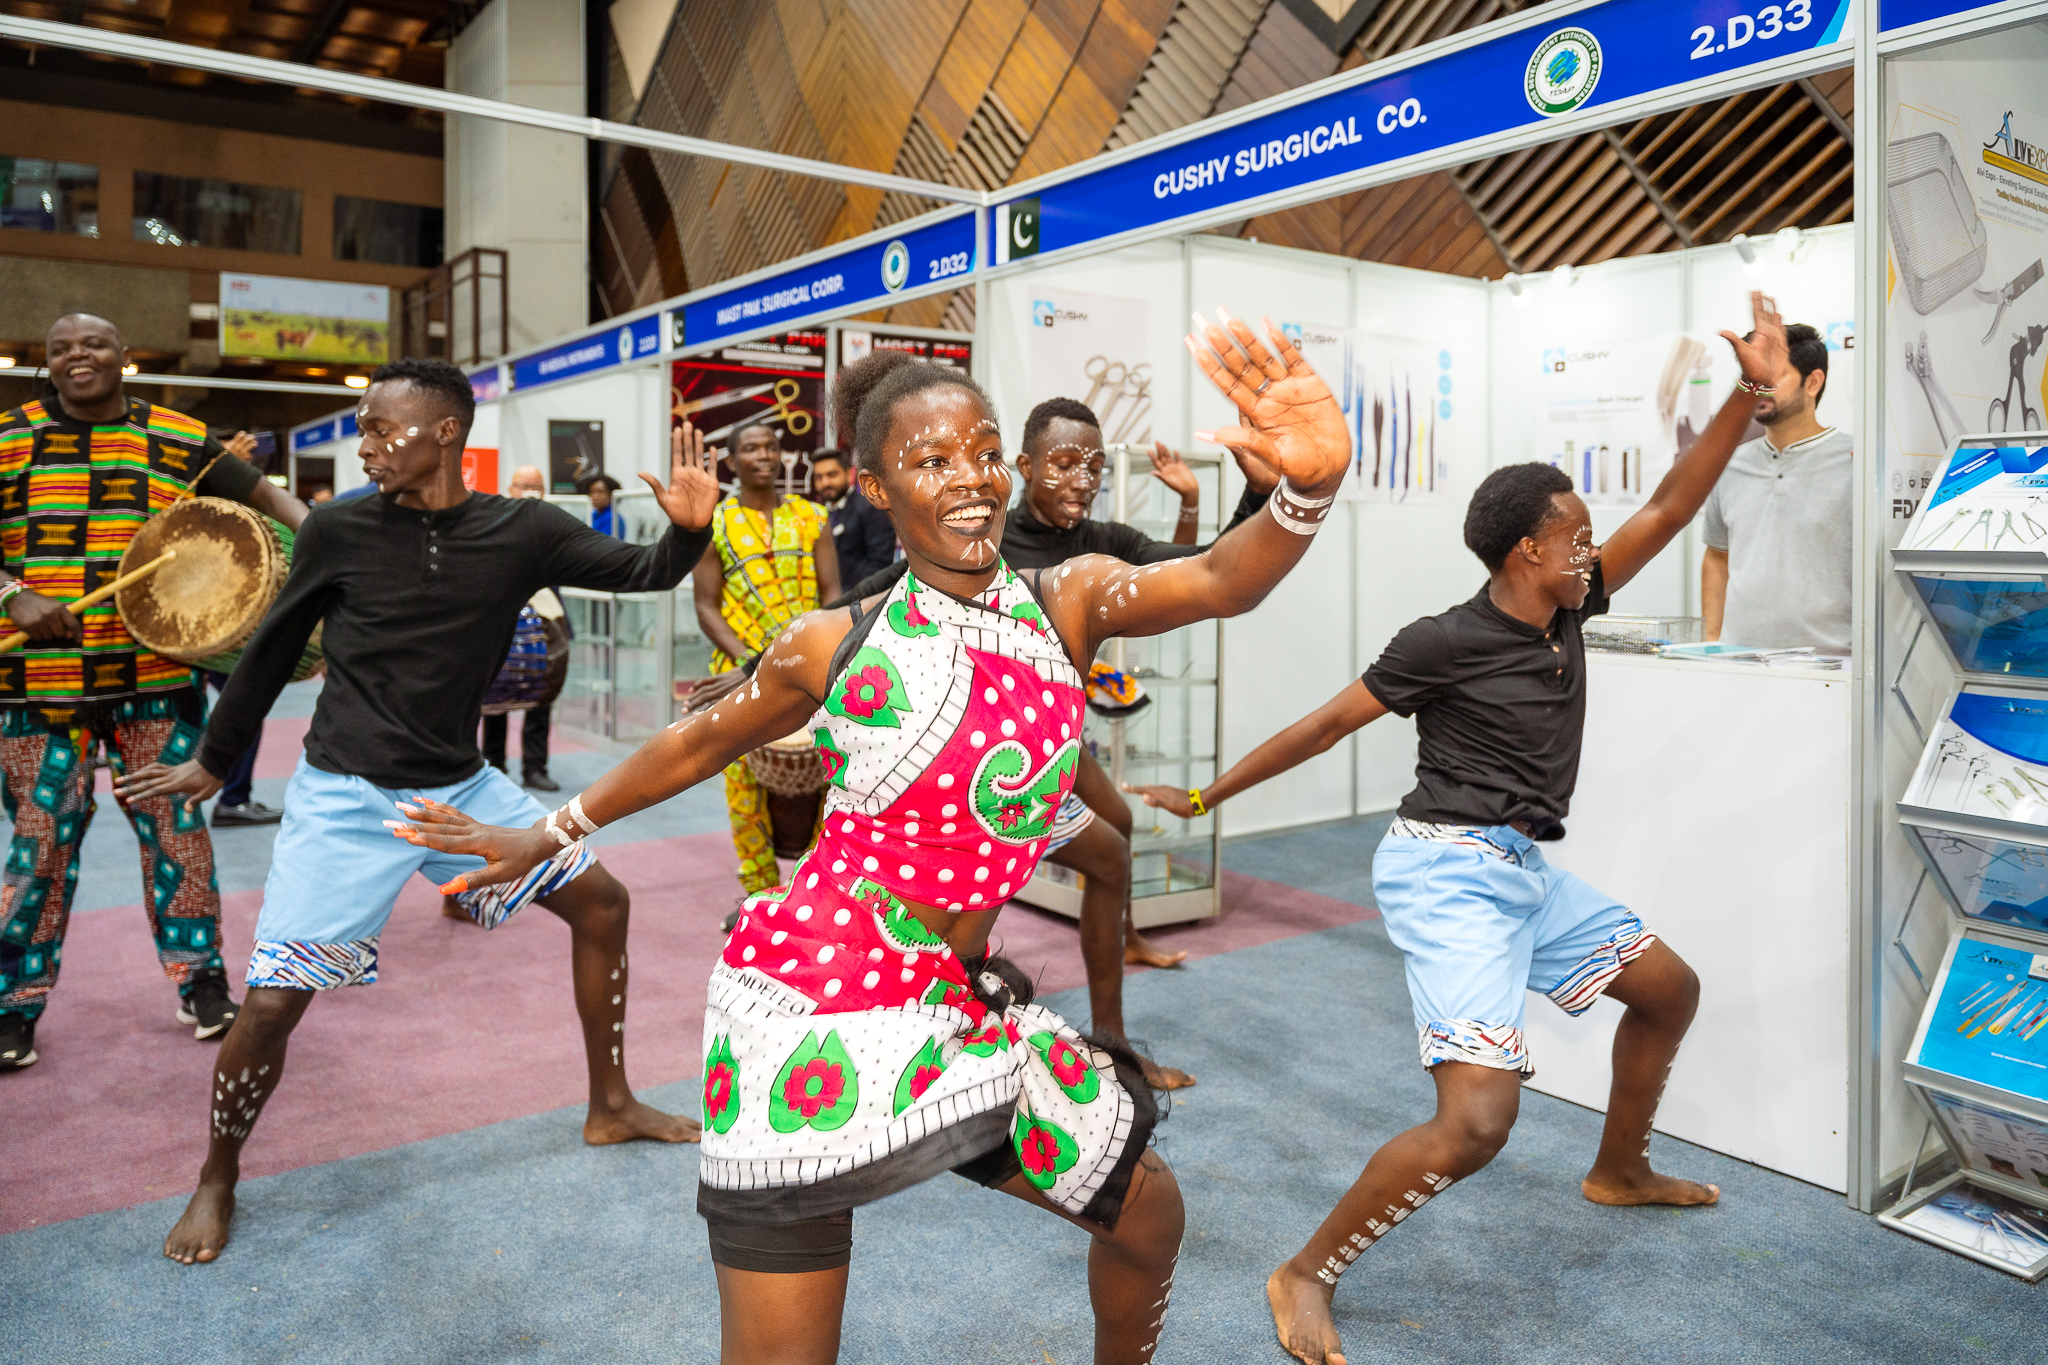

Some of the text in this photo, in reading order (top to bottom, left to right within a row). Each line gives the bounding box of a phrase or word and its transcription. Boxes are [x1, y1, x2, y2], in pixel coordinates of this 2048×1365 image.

[1690, 0, 1813, 60] 2.D33
[1560, 32, 1595, 50] AUTHORITY
[1153, 97, 1428, 199] CUSHY SURGICAL CO.
[1986, 170, 1997, 181] Expo
[1999, 175, 2018, 190] Elevating
[2018, 182, 2034, 195] Surgical
[929, 251, 969, 280] 2.D32
[761, 283, 811, 314] SURGICAL
[811, 273, 846, 299] CORP.
[1054, 309, 1089, 321] CUSHY
[1302, 331, 1338, 345] CUSHY
[1567, 350, 1611, 363] CUSHY
[1921, 477, 1932, 489] IS
